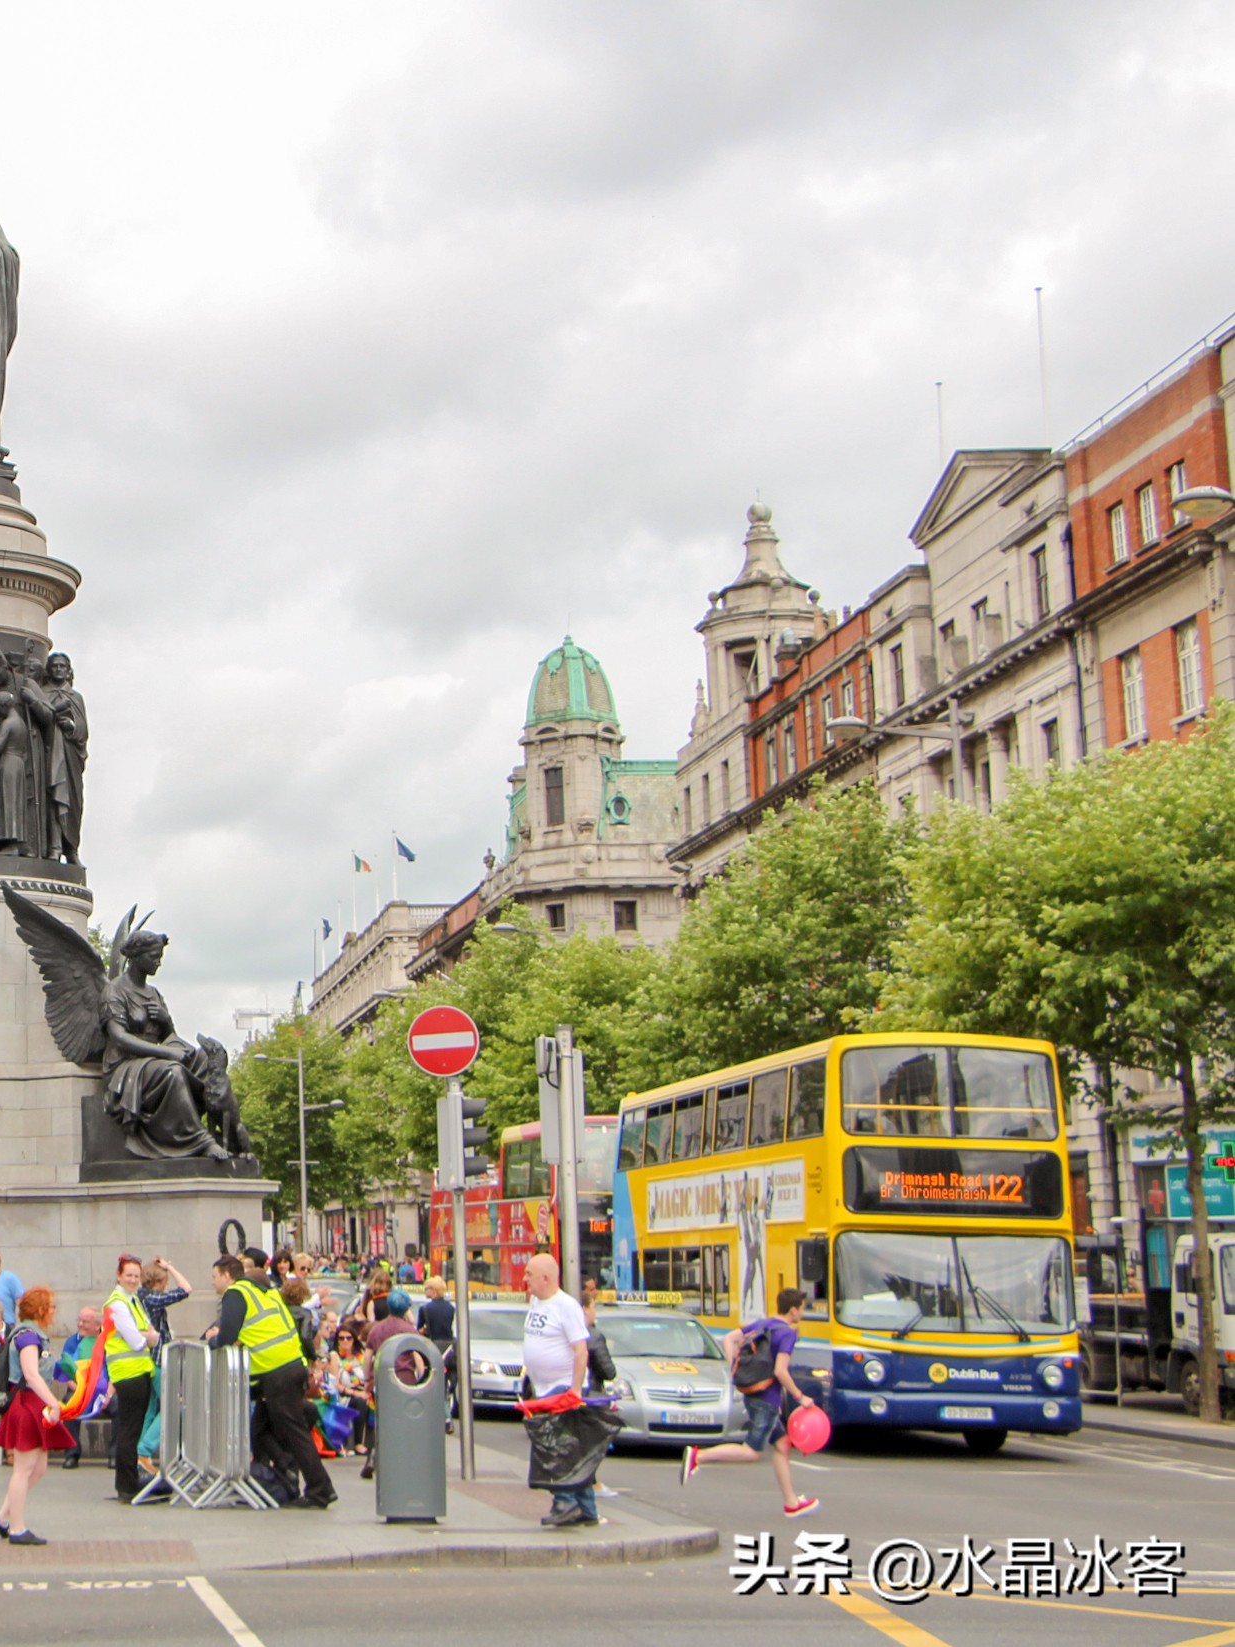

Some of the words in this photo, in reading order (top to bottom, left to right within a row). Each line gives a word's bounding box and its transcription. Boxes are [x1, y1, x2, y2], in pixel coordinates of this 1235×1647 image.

[885, 1171, 945, 1186] Drimnagh
[949, 1172, 982, 1187] Road
[880, 1185, 898, 1199] Br.
[987, 1173, 1023, 1202] 122
[655, 1186, 692, 1219] MAGIC
[695, 1180, 732, 1216] MIKE
[589, 1218, 608, 1233] Tour
[620, 1292, 646, 1301] TAXI
[948, 1367, 979, 1379] Dublin
[980, 1368, 1000, 1379] Bus
[1002, 1383, 1033, 1392] VOLVO
[65, 1579, 187, 1590] LOOK
